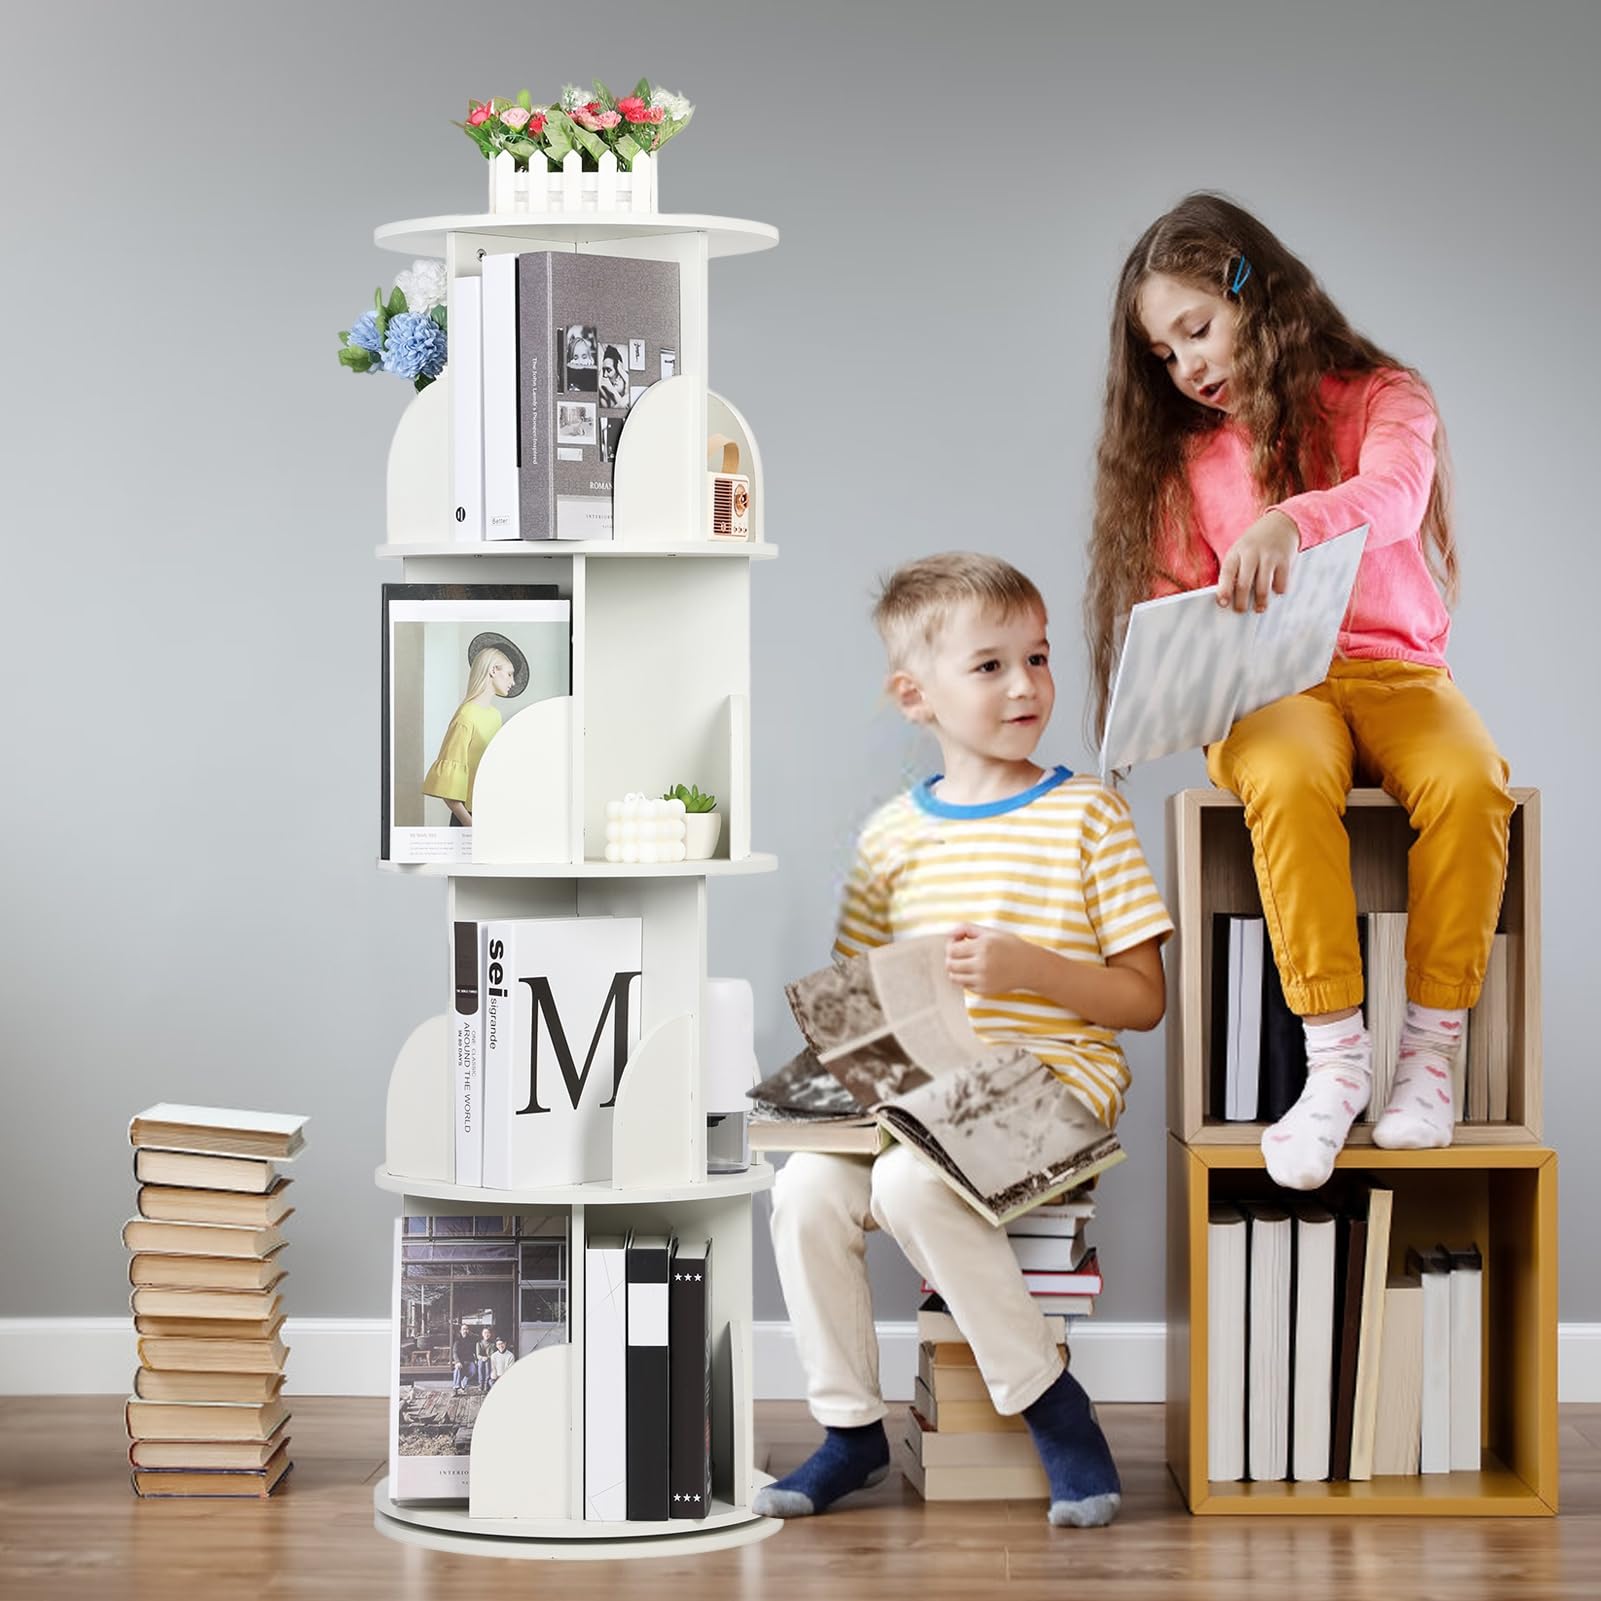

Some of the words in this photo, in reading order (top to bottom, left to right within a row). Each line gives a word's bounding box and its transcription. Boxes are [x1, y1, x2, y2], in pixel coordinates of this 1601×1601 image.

[488, 938, 508, 998] sei
[463, 1021, 471, 1068] AROUND
[489, 998, 498, 1050] sigrande
[515, 971, 642, 1115] M
[464, 1093, 472, 1133] WORLD
